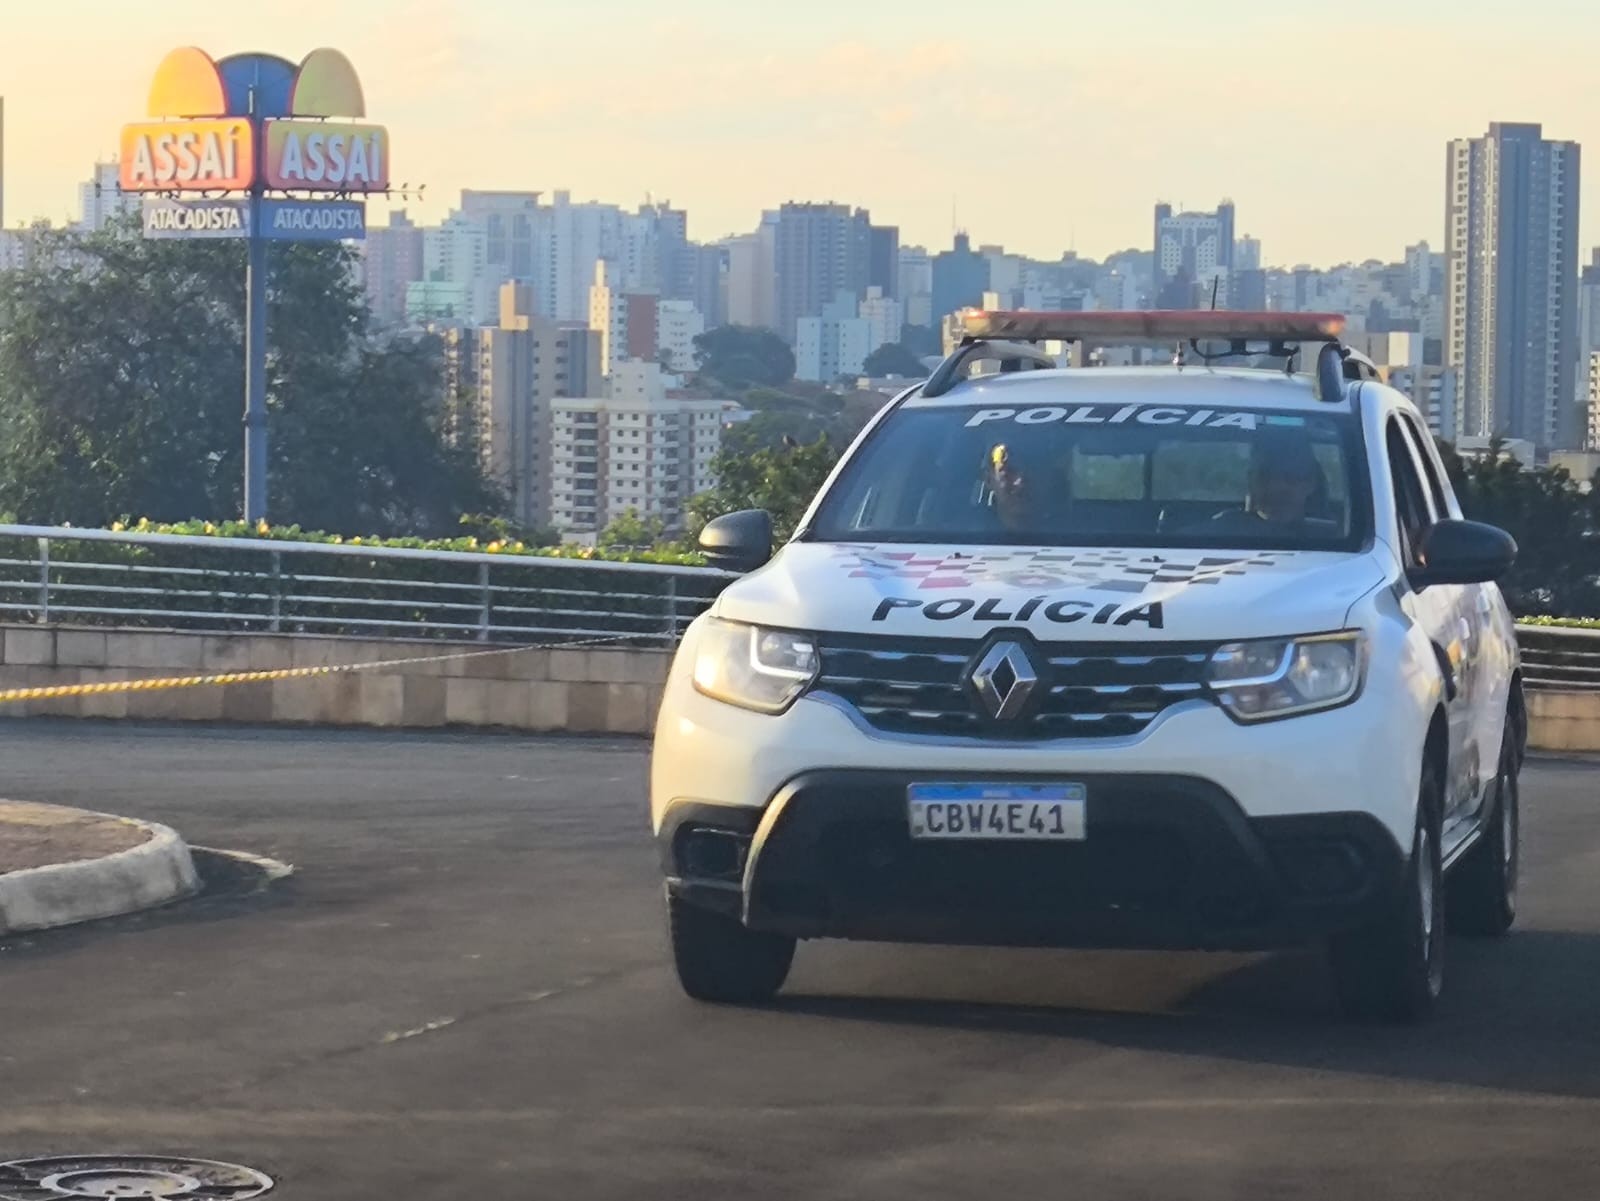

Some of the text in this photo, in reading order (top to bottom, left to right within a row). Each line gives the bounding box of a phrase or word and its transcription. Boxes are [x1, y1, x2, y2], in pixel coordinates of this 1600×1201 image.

[149, 206, 241, 231] ATACADISTA
[273, 207, 364, 230] ATACADISTA
[964, 402, 1257, 430] POLÍCIA
[871, 595, 1165, 629] POLÍCIA
[926, 803, 1065, 834] CBW4E41
